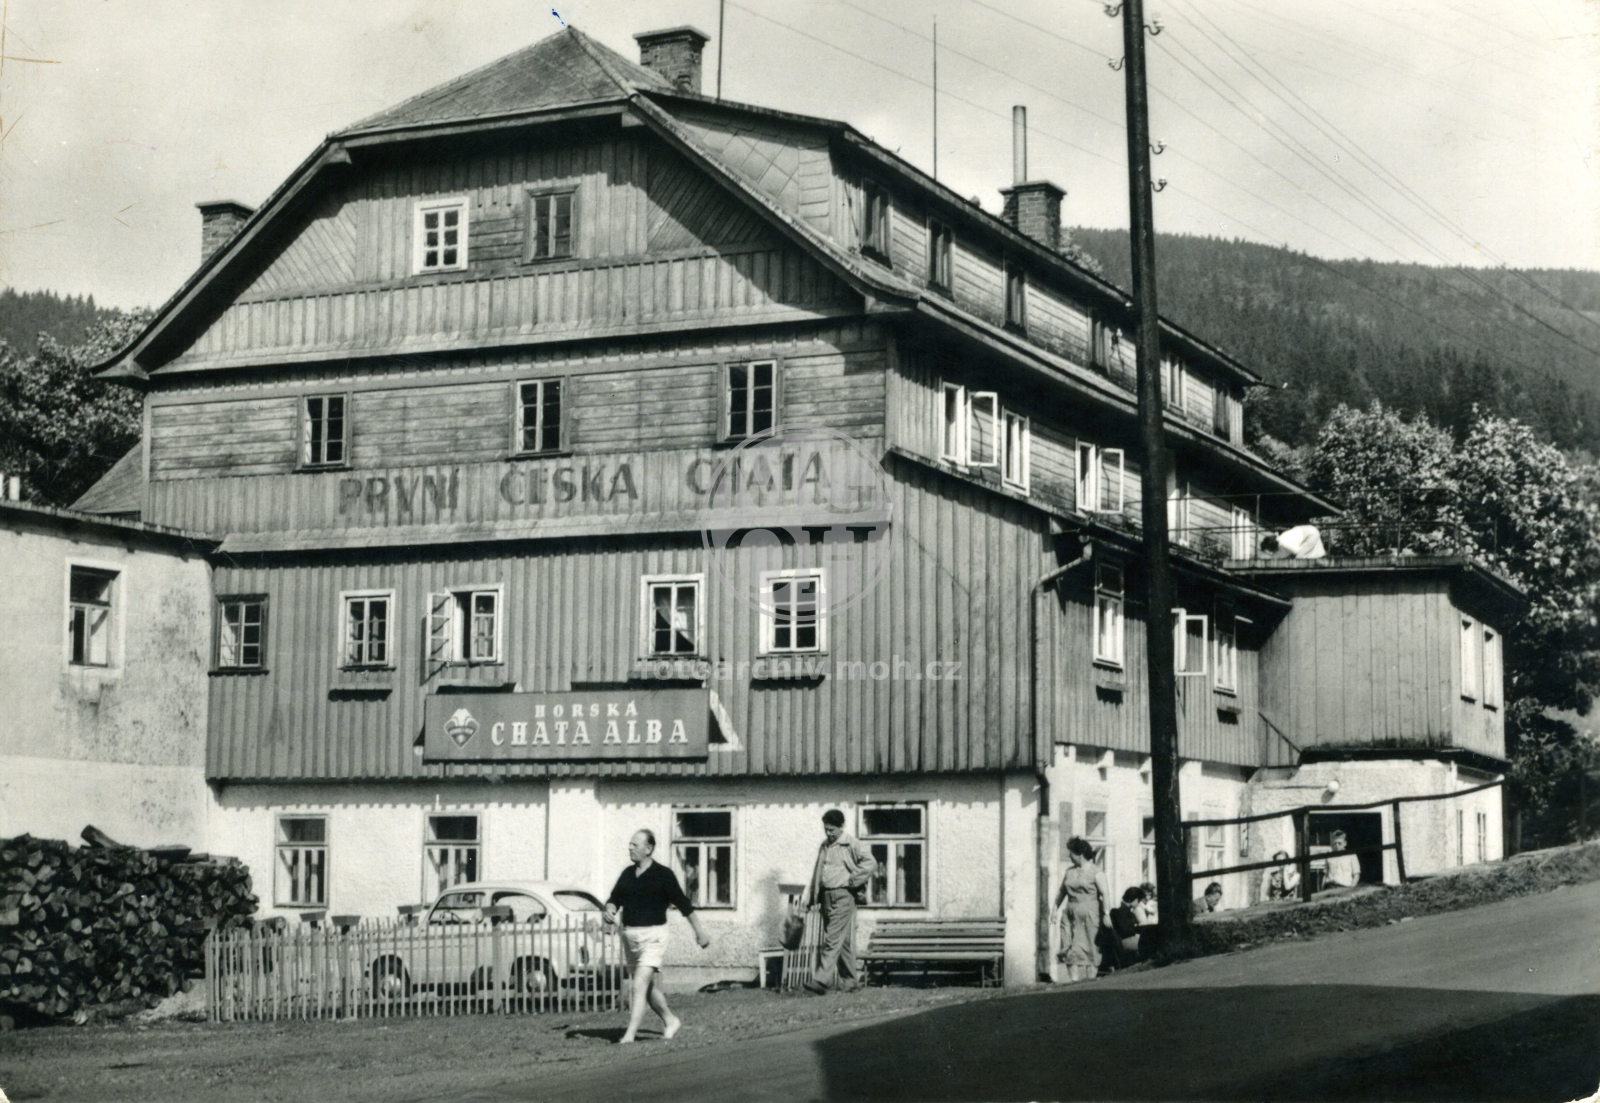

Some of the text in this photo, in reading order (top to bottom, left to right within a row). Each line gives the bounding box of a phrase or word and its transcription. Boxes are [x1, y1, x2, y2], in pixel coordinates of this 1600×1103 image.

[534, 700, 639, 718] HORSKÁ
[490, 718, 689, 747] CHATA ALBA
